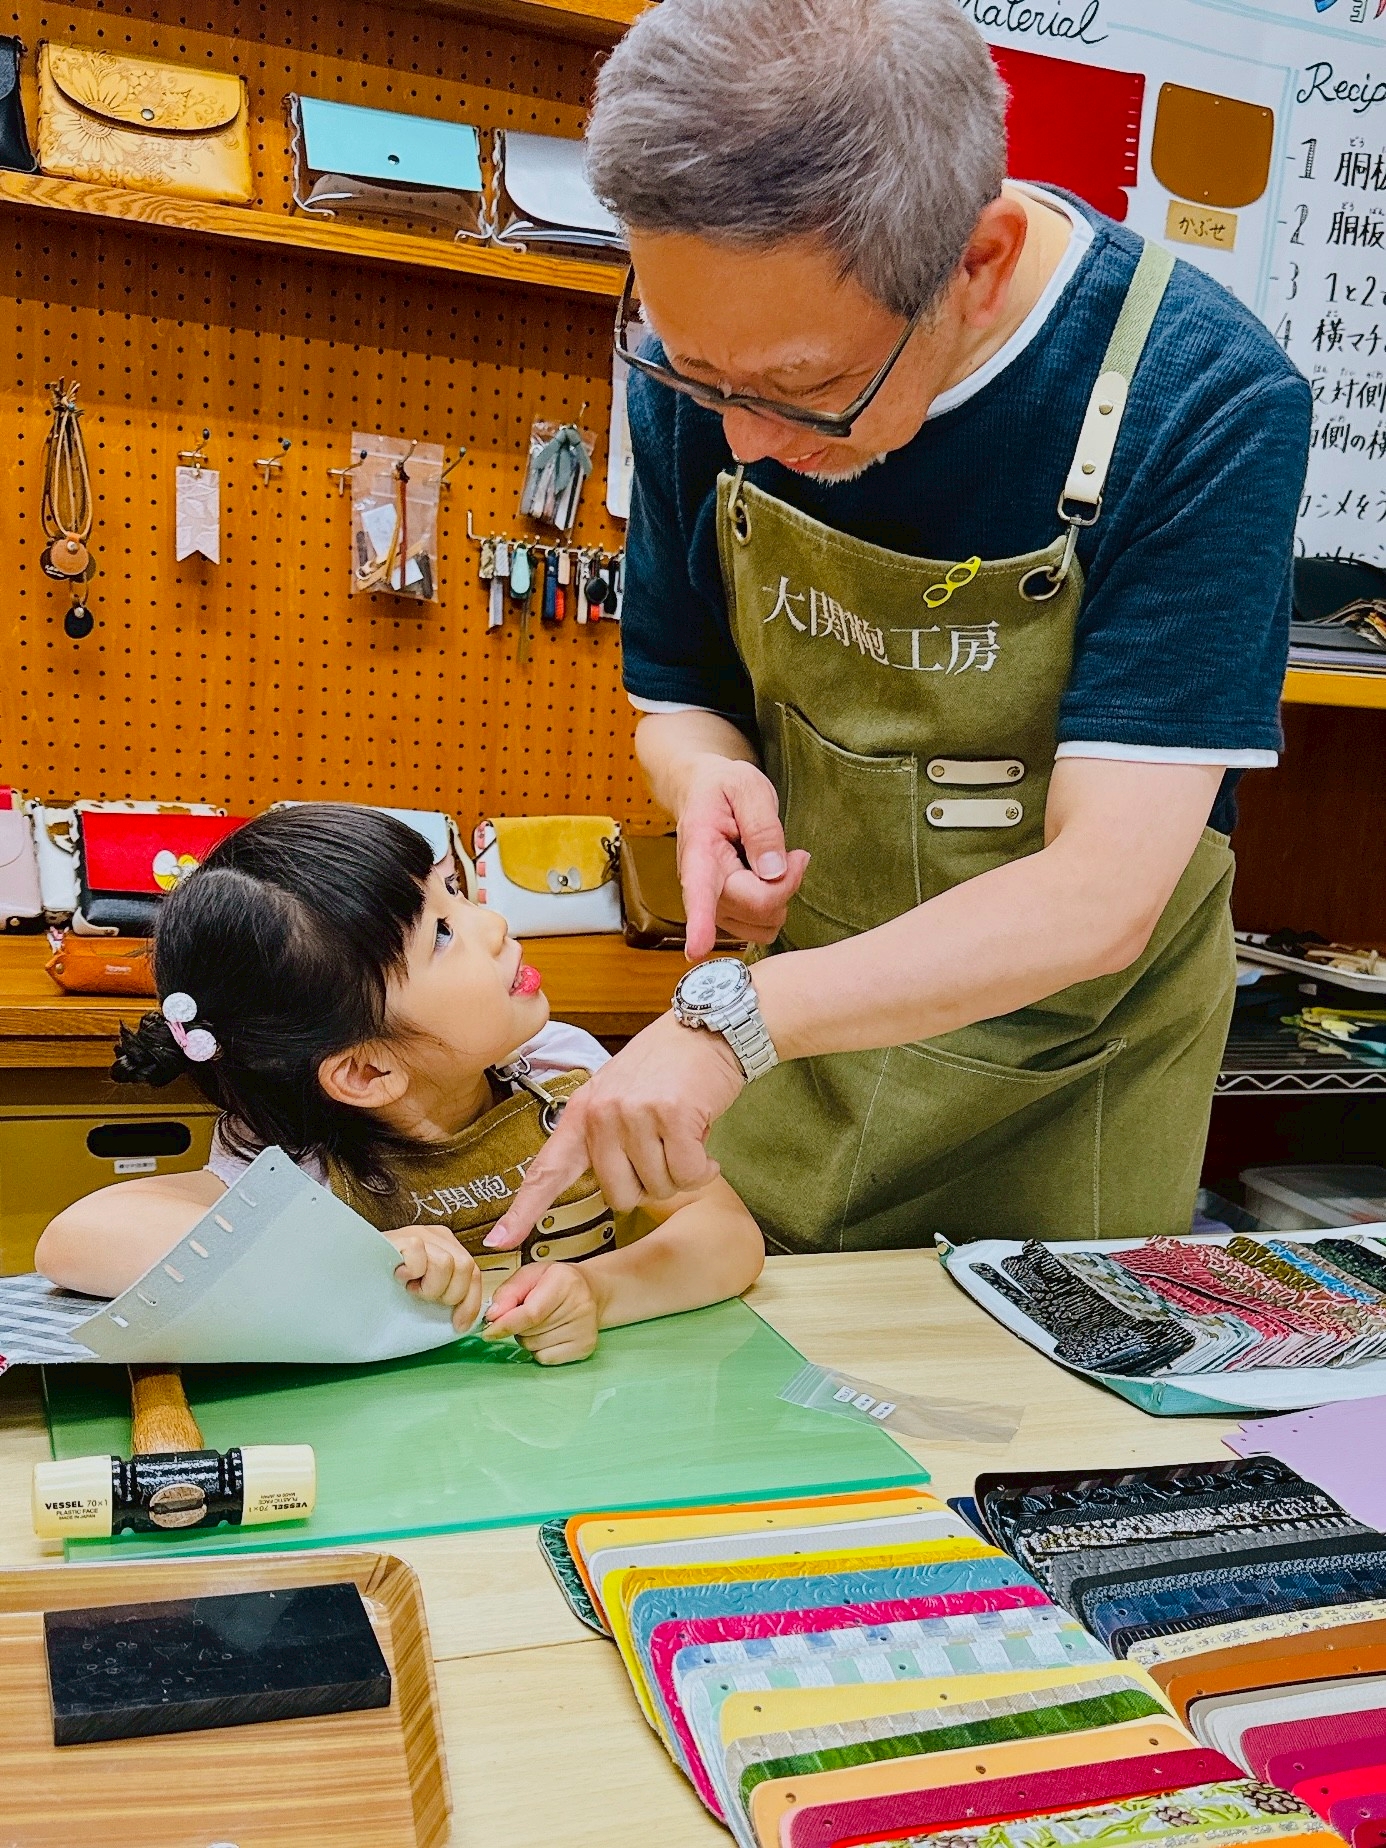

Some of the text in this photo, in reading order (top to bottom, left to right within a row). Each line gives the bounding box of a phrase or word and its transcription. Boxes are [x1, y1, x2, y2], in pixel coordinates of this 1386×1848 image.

[1179, 217, 1226, 242] かぶせ
[1326, 211, 1385, 250] 胴板
[762, 576, 1000, 678] 大関鞄工房
[45, 1501, 83, 1510] VESSEL
[272, 1502, 308, 1510] VESSEL
